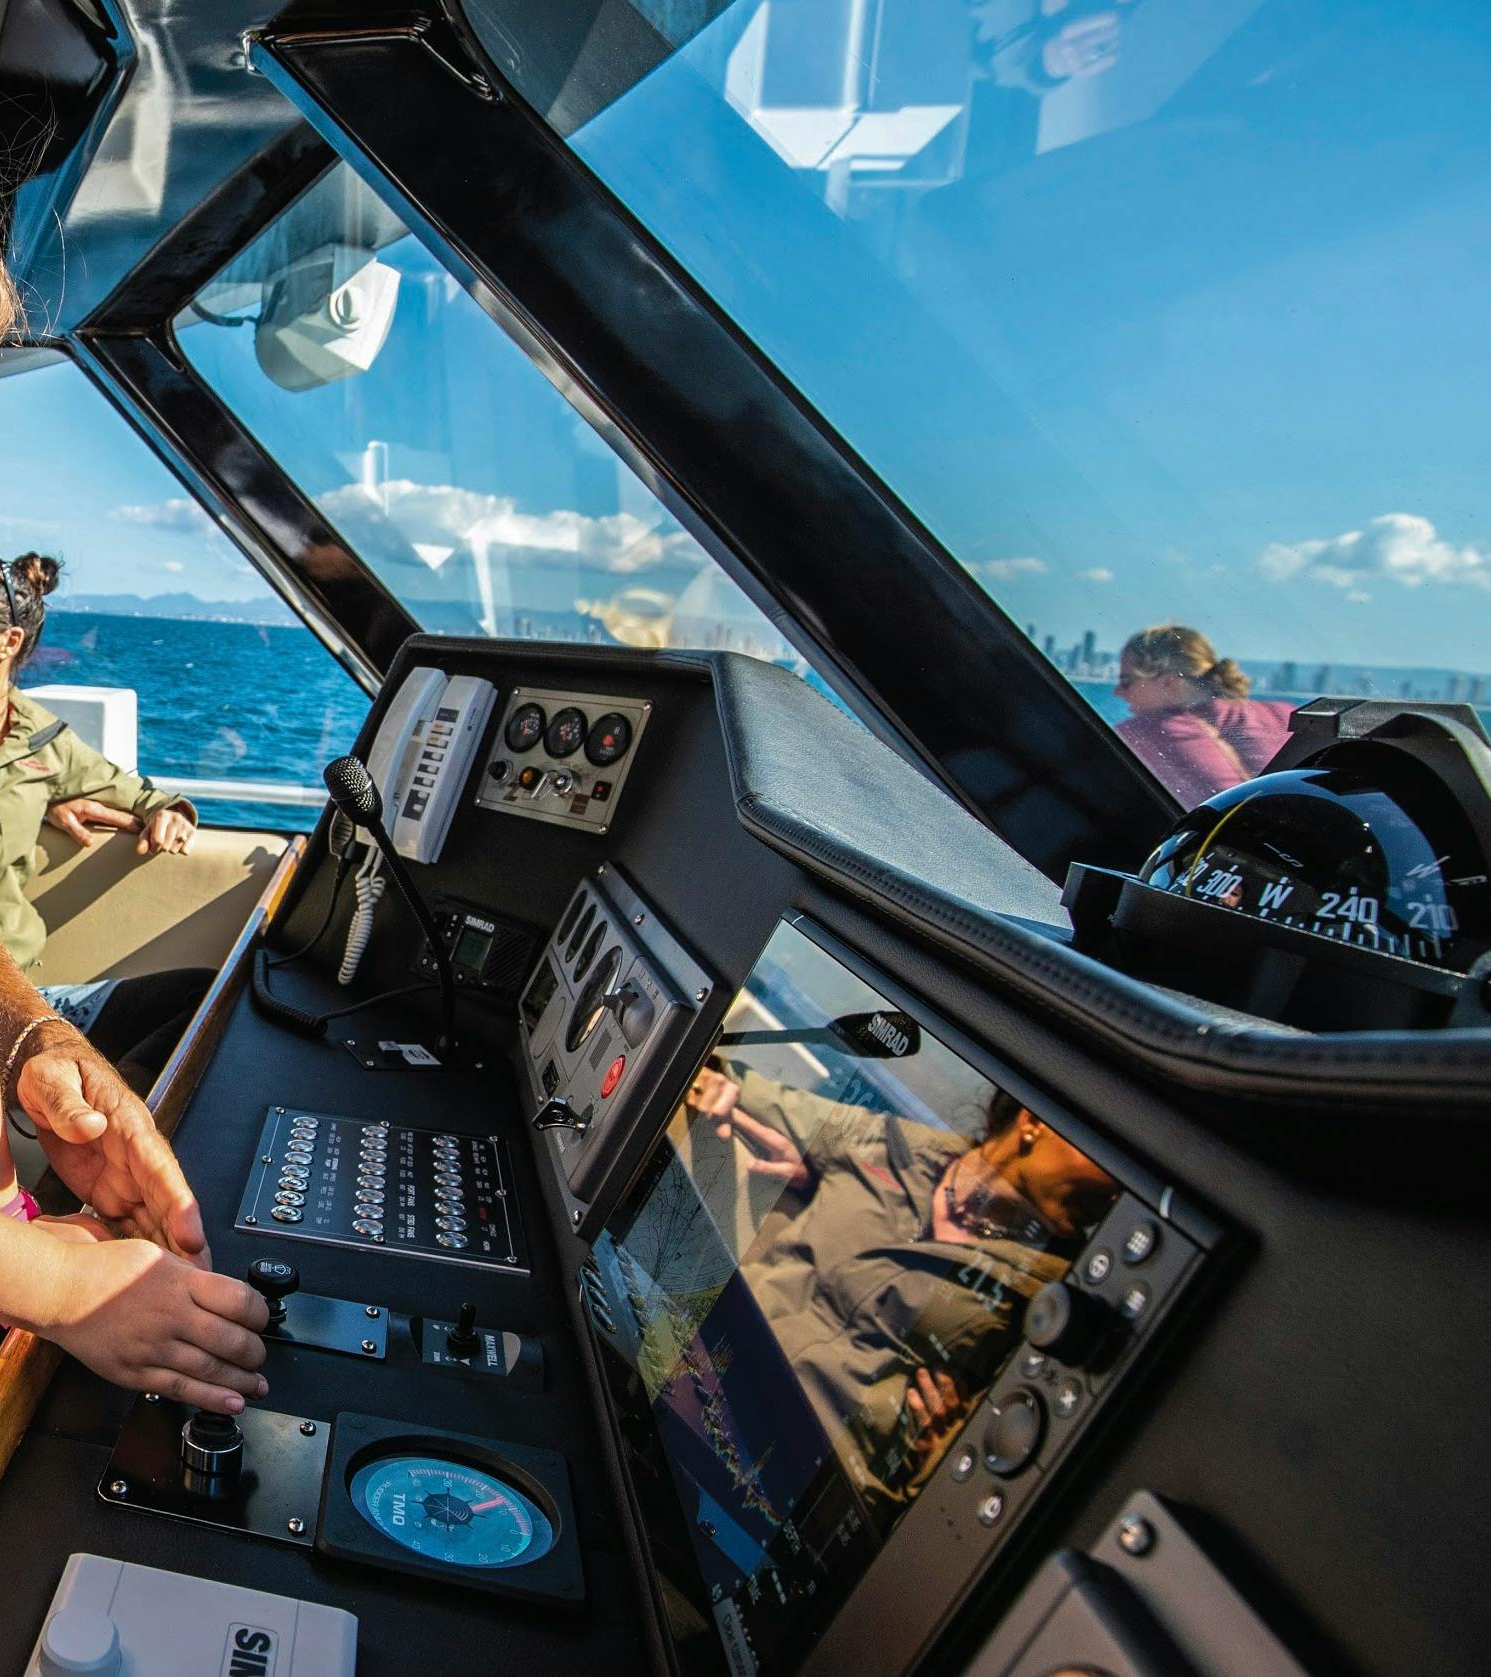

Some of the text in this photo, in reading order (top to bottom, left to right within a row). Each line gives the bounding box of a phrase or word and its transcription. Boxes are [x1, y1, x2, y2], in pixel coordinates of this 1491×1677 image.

[1197, 868, 1243, 899] 300
[1258, 882, 1294, 909] W
[1316, 892, 1379, 925] 240
[1407, 901, 1459, 931] 210
[465, 915, 495, 933] SIMRAD
[867, 1013, 910, 1057] SIMRAD
[485, 1334, 498, 1367] MAXWELL
[393, 1493, 406, 1526] TMQ
